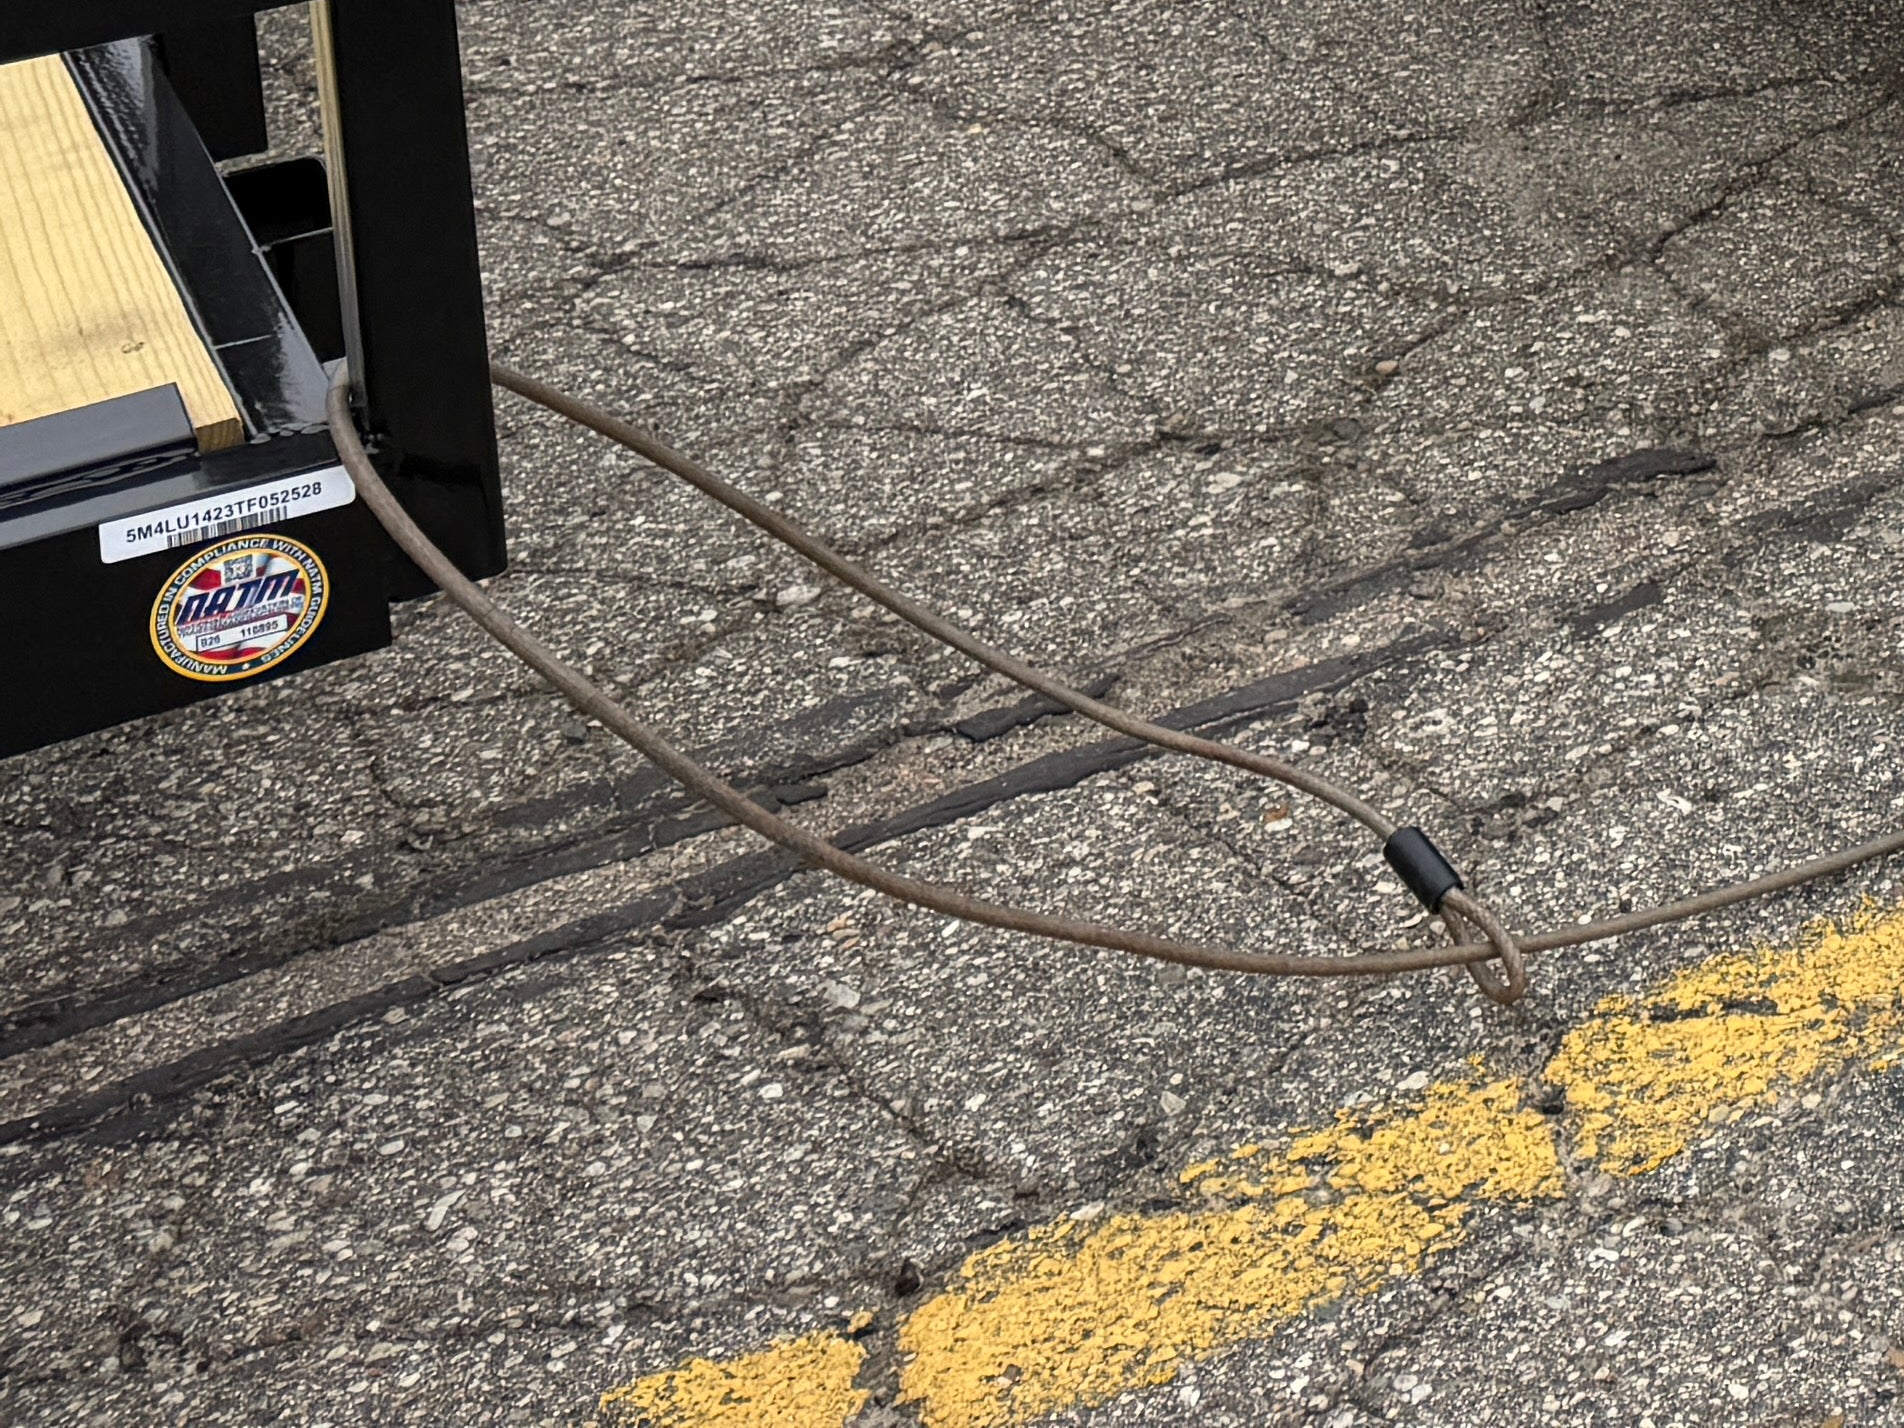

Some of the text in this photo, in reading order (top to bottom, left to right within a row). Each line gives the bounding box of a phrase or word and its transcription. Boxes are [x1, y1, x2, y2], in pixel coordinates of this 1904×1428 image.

[125, 481, 323, 544] 5M4LU1423TF052528
[175, 538, 271, 586] COMPLIANCE
[271, 539, 305, 562] WITH
[155, 603, 228, 675] MANUFACTURED
[260, 596, 322, 664] GUIDELINES
